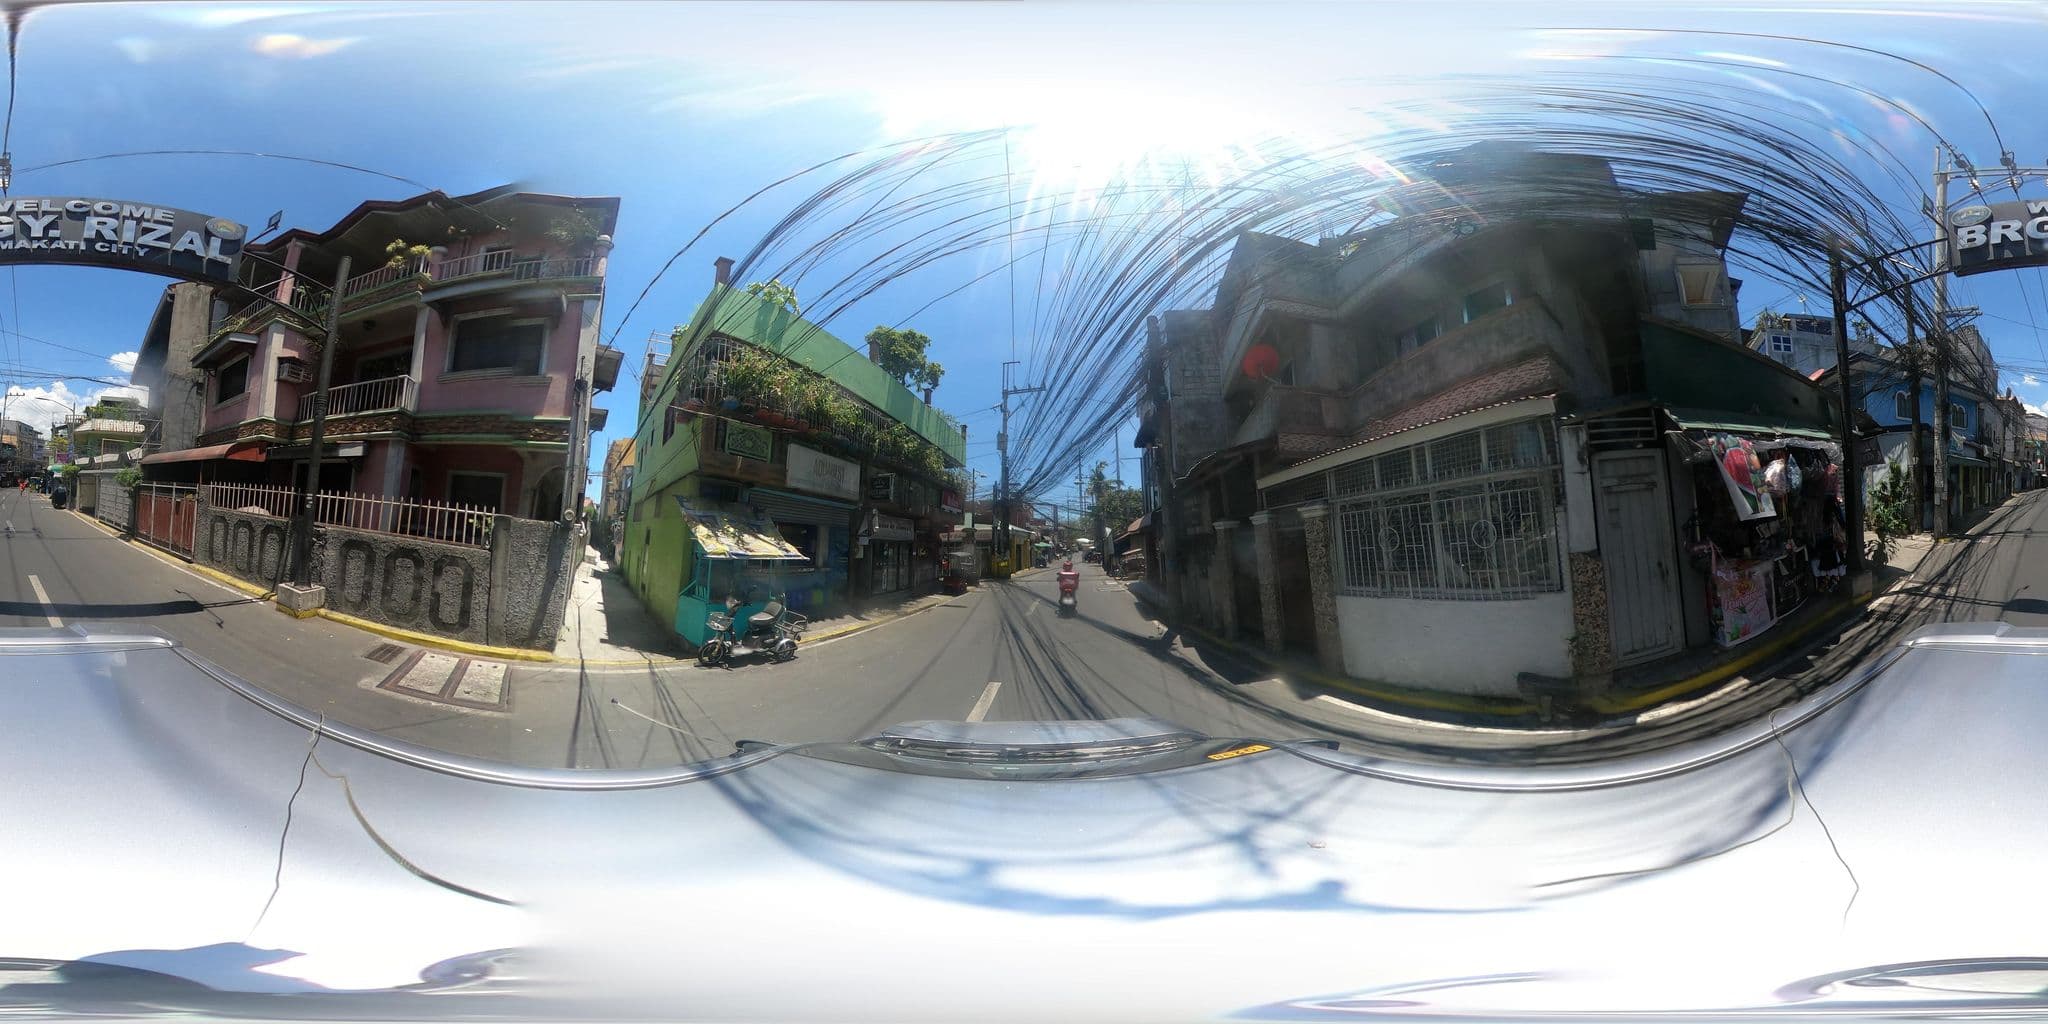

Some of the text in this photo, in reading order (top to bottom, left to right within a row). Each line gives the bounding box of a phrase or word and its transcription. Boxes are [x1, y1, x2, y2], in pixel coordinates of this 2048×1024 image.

[0, 240, 149, 257] MAKATI CITY
[83, 216, 232, 265] RIZAL
